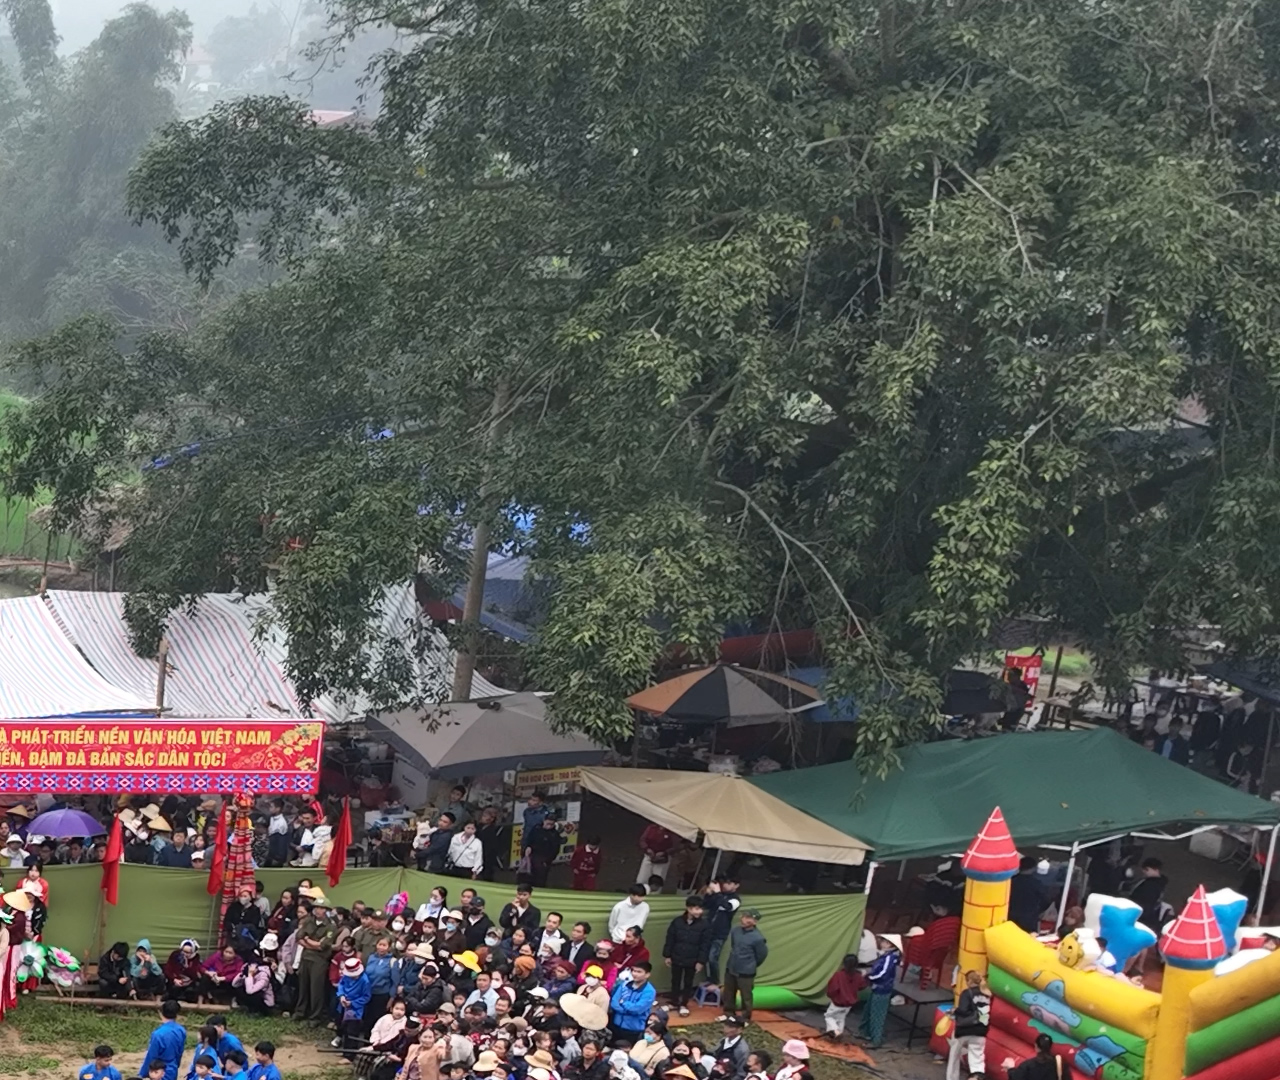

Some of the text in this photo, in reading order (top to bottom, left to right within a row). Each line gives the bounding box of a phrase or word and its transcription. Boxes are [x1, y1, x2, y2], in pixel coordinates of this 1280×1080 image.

[11, 727, 49, 744] PHÁT
[133, 727, 163, 744] VĂN
[166, 727, 197, 744] HÓA
[201, 727, 232, 747] VIỆT
[235, 730, 271, 744] NAM
[29, 749, 63, 768] ĐẬM
[66, 749, 86, 766] ĐÀ
[90, 747, 121, 766] BẢN
[125, 747, 154, 766] SẮC
[158, 749, 189, 766] DÂN
[193, 750, 226, 769] TỘC!
